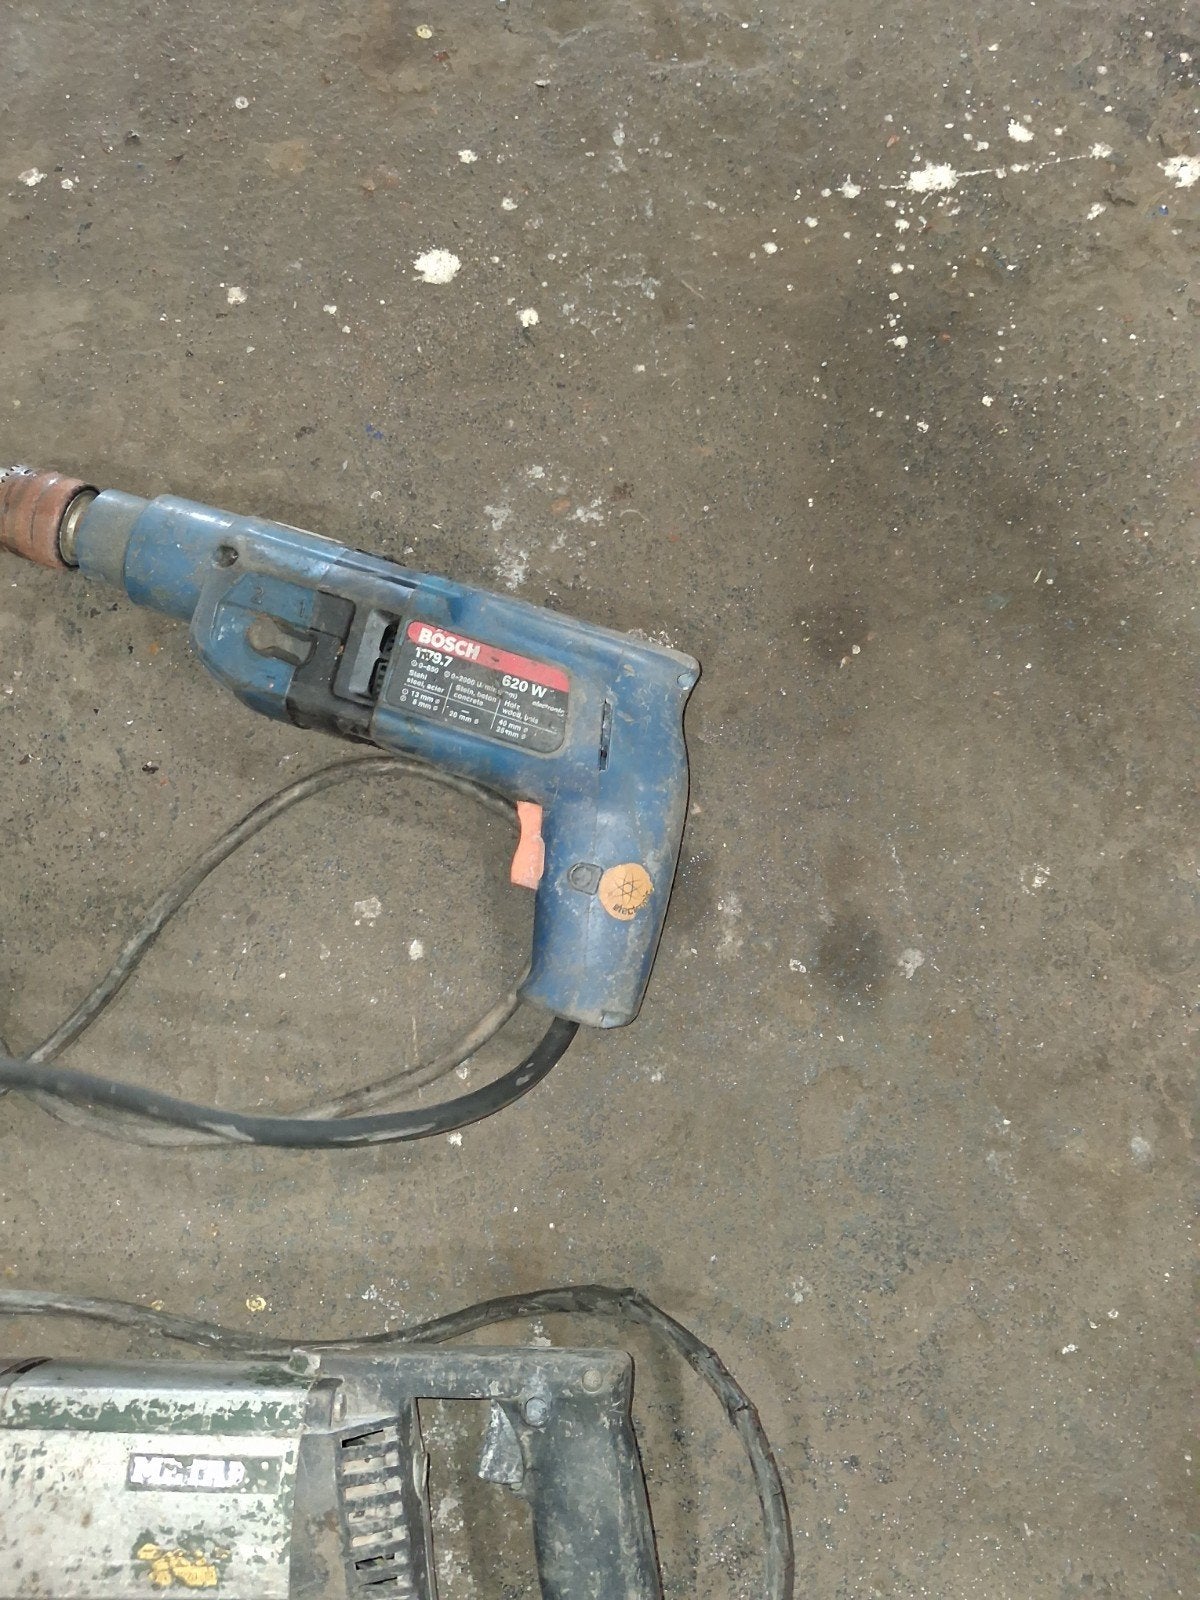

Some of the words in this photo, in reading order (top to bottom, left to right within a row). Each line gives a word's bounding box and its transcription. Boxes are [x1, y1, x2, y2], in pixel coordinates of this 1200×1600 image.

[418, 627, 480, 660] BOSCH
[502, 674, 528, 693] 620
[531, 684, 548, 698] W
[453, 692, 484, 707] concrete
